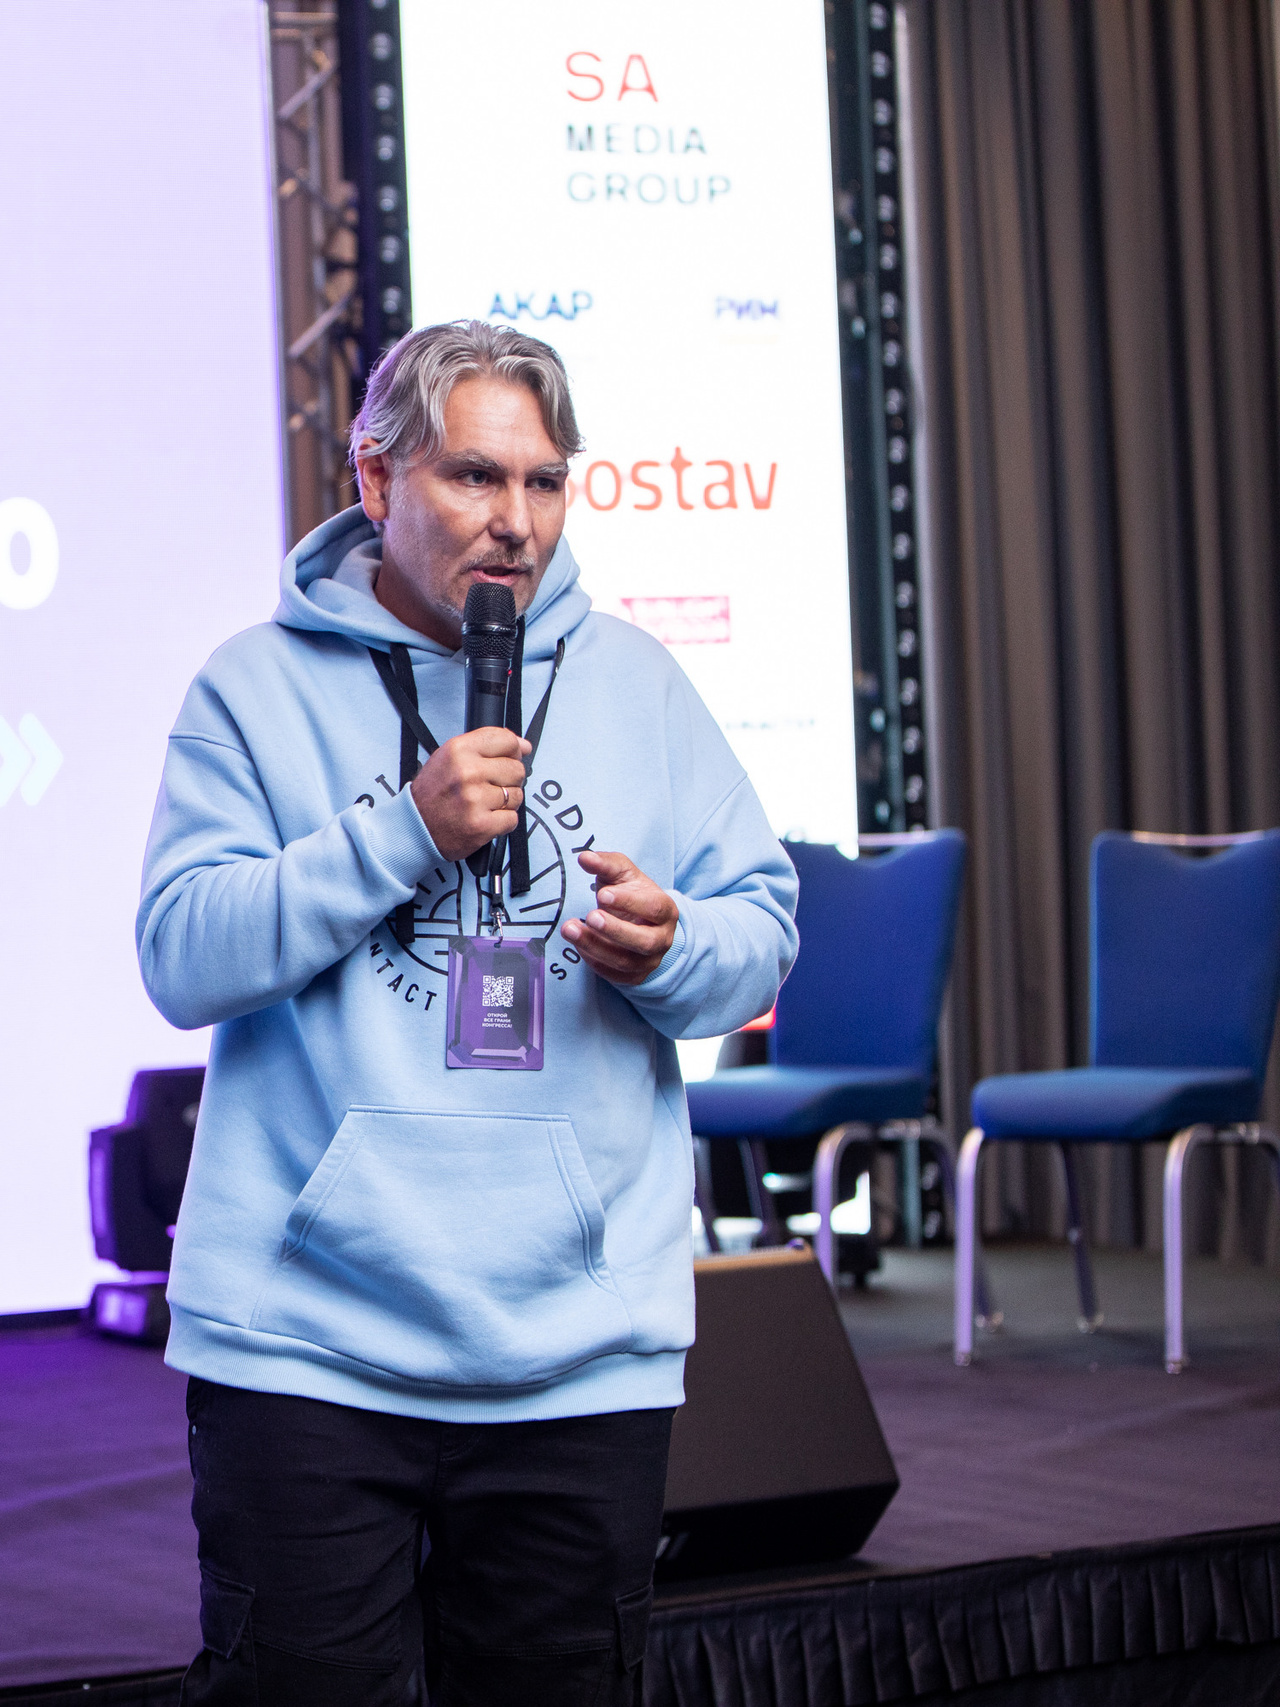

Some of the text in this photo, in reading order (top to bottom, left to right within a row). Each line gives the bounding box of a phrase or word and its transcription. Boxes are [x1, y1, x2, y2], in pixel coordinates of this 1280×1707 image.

[566, 51, 658, 103] SA
[566, 123, 708, 155] MEDIA
[566, 172, 732, 205] GROUP
[532, 780, 595, 853] ODY
[370, 930, 437, 1011] NTACT
